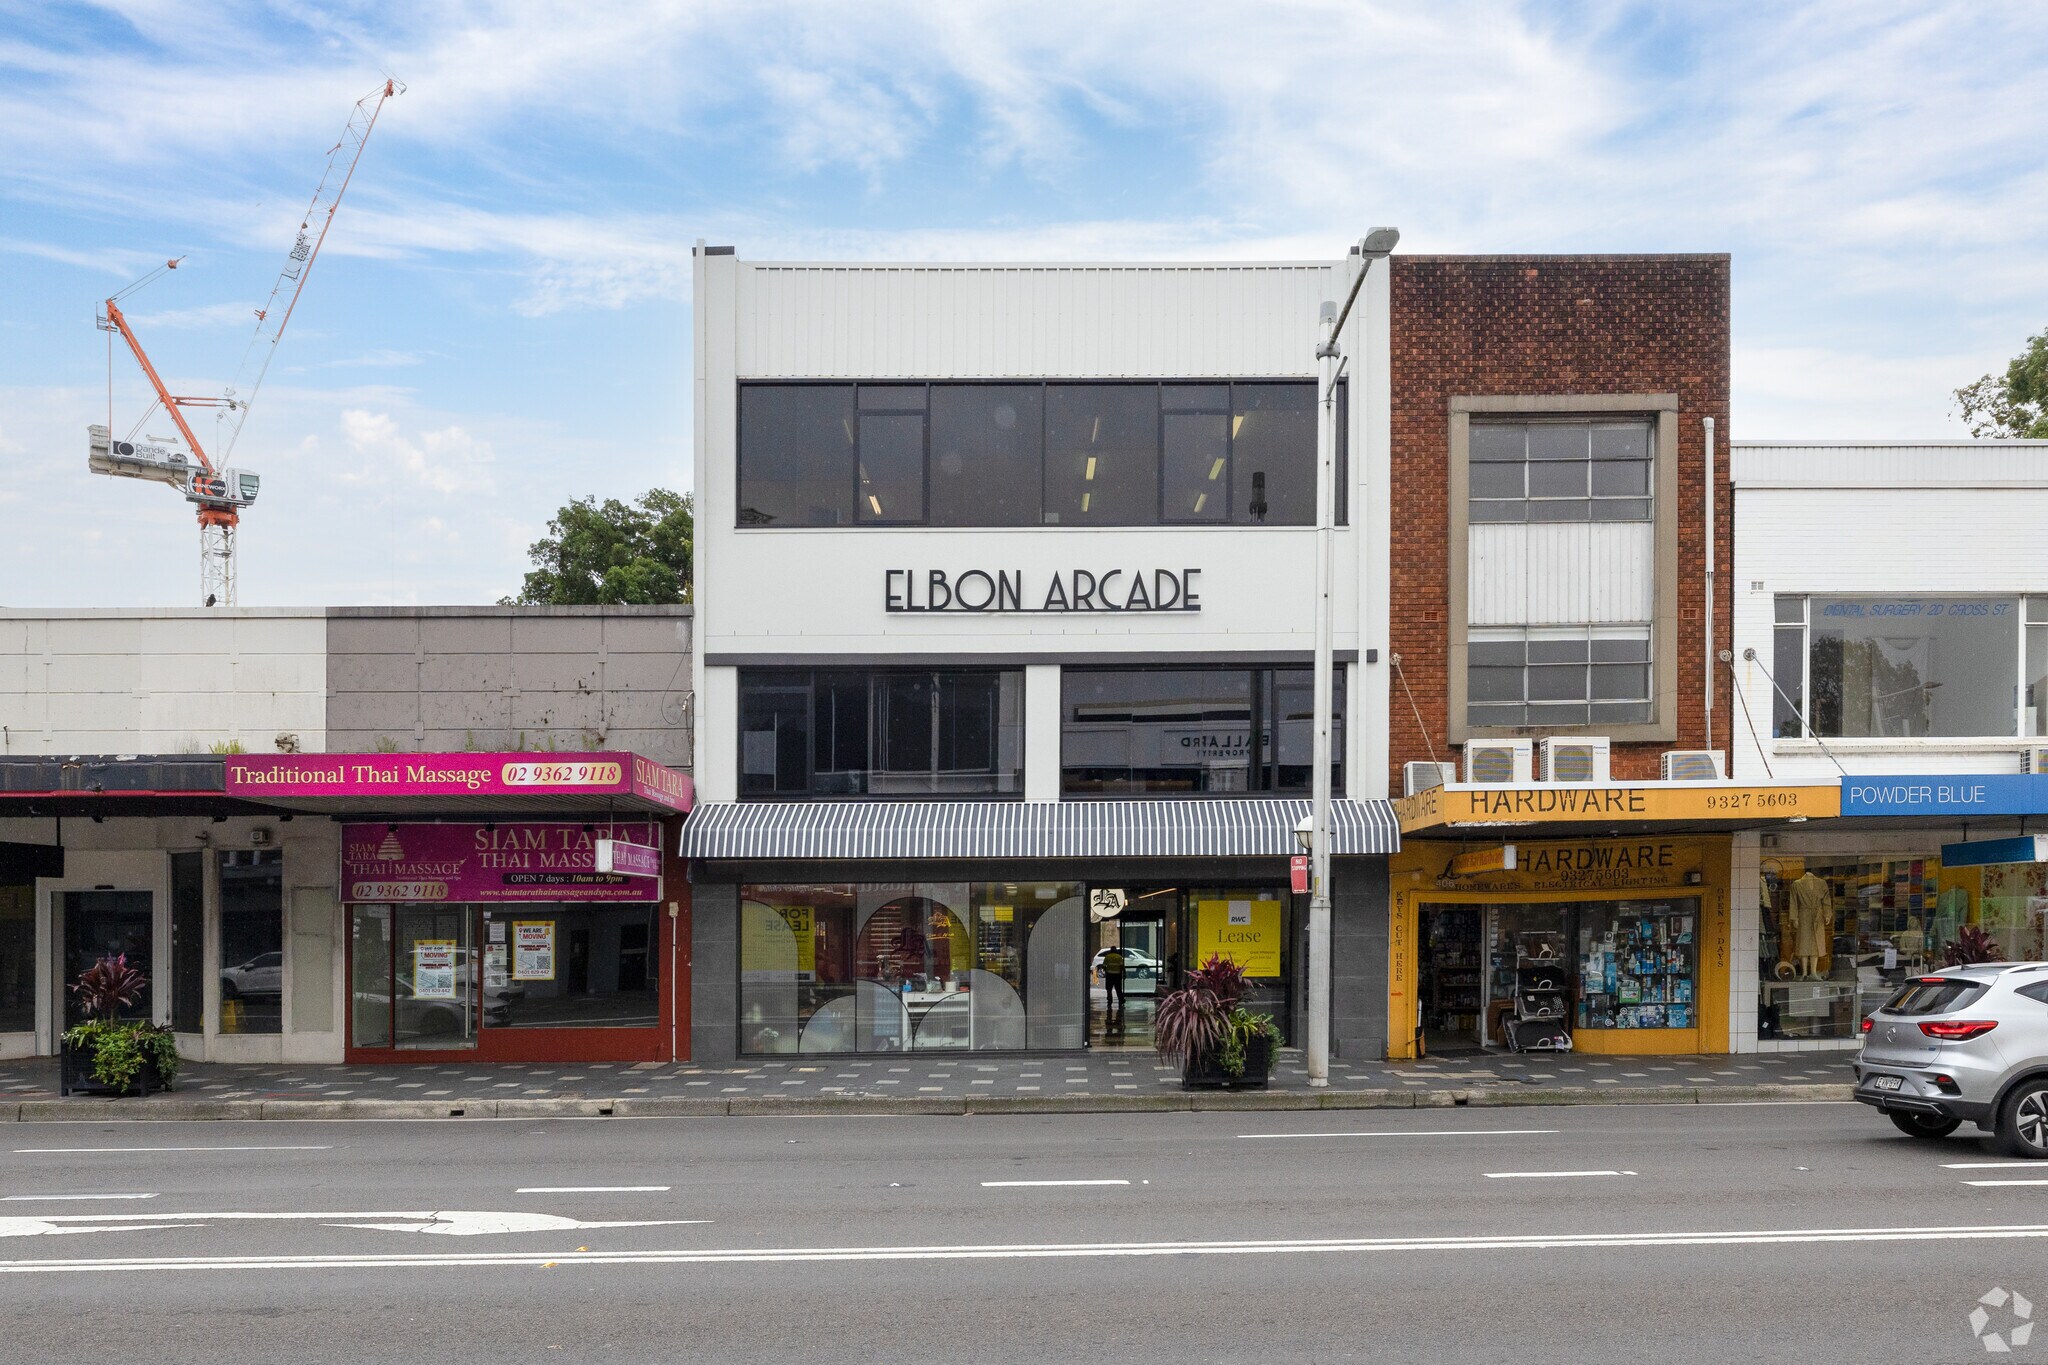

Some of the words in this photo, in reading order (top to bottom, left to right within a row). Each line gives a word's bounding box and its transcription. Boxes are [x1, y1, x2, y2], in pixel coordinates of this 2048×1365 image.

[136, 444, 165, 455] Dande
[136, 450, 155, 460] Built
[885, 569, 1021, 611] ELBON
[1043, 568, 1201, 611] ARCADE
[1823, 604, 1865, 617] DENTAL
[1869, 604, 1926, 616] SURGERY
[1948, 604, 1989, 616] CROSS
[1992, 604, 2009, 616] ST
[230, 766, 345, 784] Traditional
[352, 765, 399, 783] Thai
[405, 765, 491, 789] Massage
[507, 766, 526, 782] 02
[533, 766, 571, 782] 9362
[578, 766, 617, 781] 9118
[636, 759, 660, 790] SIAM
[660, 769, 684, 798] TARA
[1470, 788, 1646, 814] HARDWARE
[1707, 794, 1751, 810] 9327
[1757, 792, 1798, 808] 5603
[1850, 786, 1931, 804] POWDER
[1938, 785, 1985, 803] BLUE
[1397, 788, 1437, 820] HARDWARE
[475, 828, 547, 850] SIAM
[349, 852, 376, 860] TARA
[350, 844, 376, 852] SIAM
[478, 852, 529, 868] THAI
[613, 850, 627, 865] THAI
[627, 853, 650, 868] MASSAGE
[1514, 845, 1673, 872] HARDWARE
[350, 863, 385, 875] THAI
[394, 863, 461, 875] MASSAGE
[1560, 868, 1629, 882] 93275603
[511, 874, 538, 883] OPEN
[539, 875, 544, 883] 7
[545, 875, 565, 884] days
[572, 874, 594, 883] 10am
[605, 874, 624, 885] 9pm
[1435, 880, 1455, 888] 406
[1455, 882, 1521, 891] HOMEWARES
[1534, 880, 1606, 889] ELECTRICAL
[1613, 876, 1668, 887] LIGHTING
[356, 885, 371, 897] 02
[377, 885, 408, 897] 9362
[413, 885, 444, 897] 9118
[480, 888, 642, 898] www.siamtarathaimassageandspa.com.au
[1717, 921, 1725, 933] 7
[1218, 929, 1261, 943] Lease
[1395, 925, 1403, 946] CUT
[1717, 938, 1725, 968] DAYS
[1395, 953, 1403, 981] HERE
